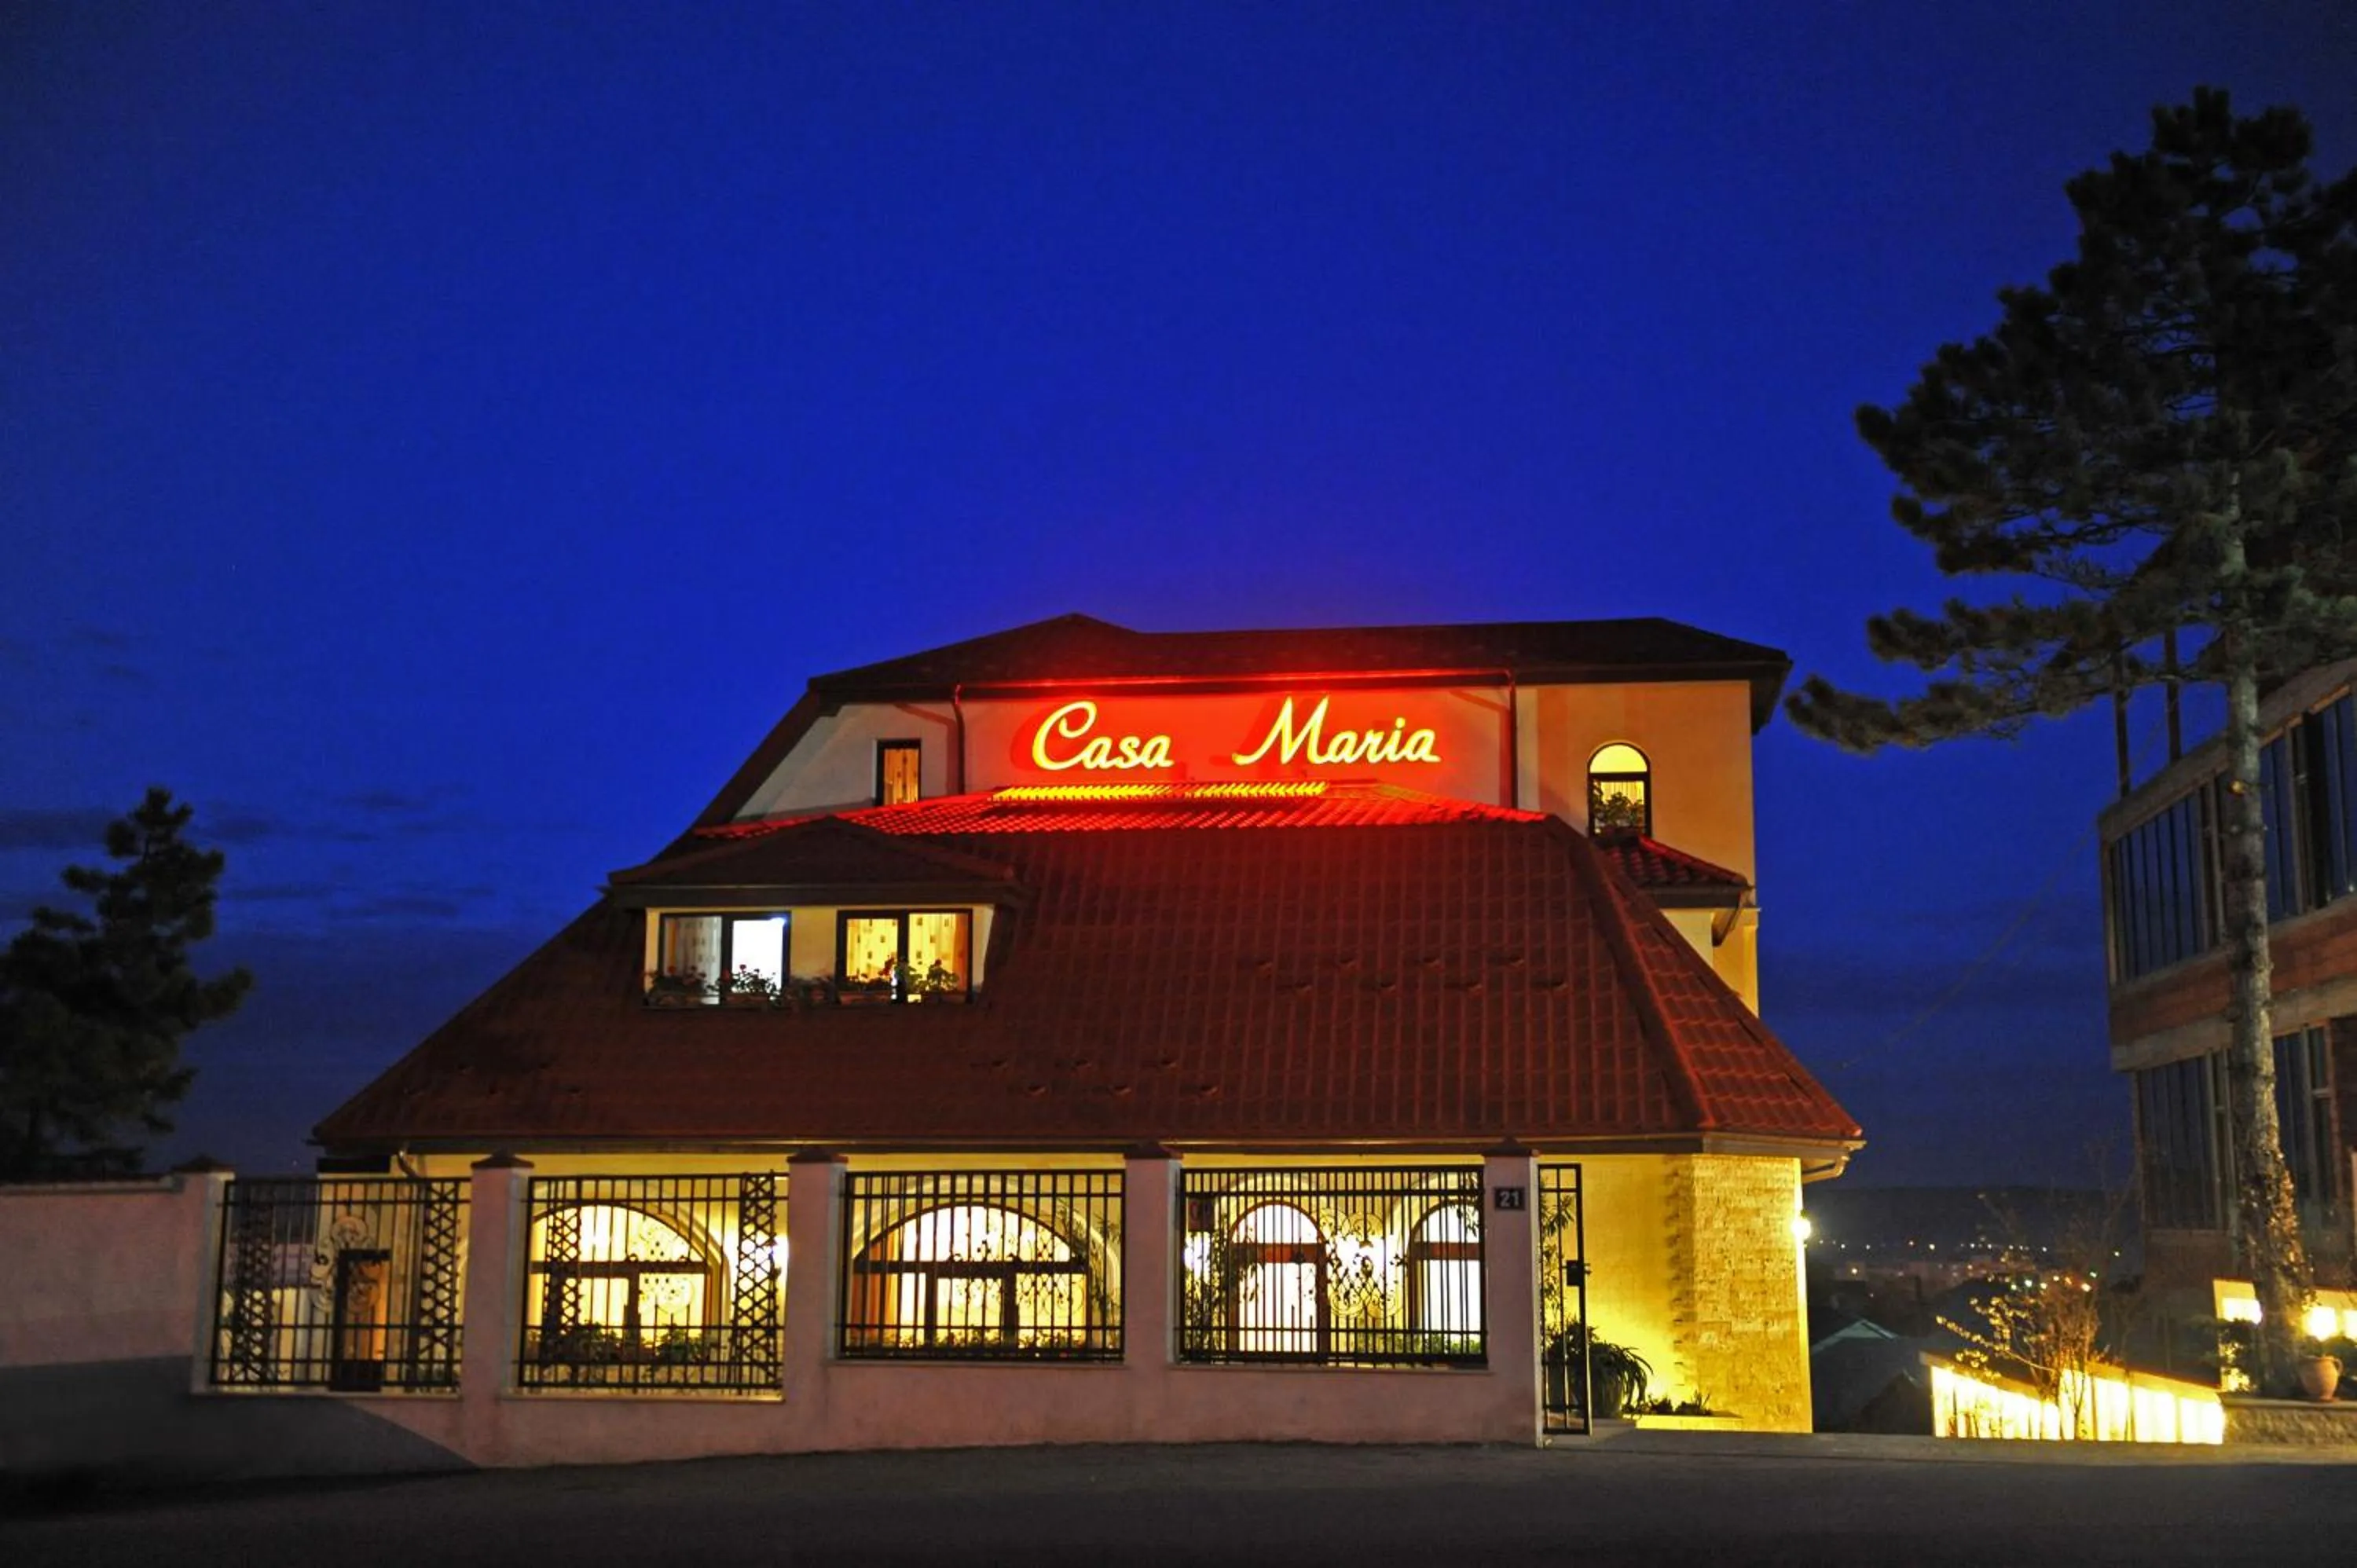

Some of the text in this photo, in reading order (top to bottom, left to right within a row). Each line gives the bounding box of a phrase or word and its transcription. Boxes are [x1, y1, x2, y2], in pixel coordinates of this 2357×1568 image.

[1032, 696, 1441, 771] Casa Maria
[1500, 1190, 1519, 1207] 21
